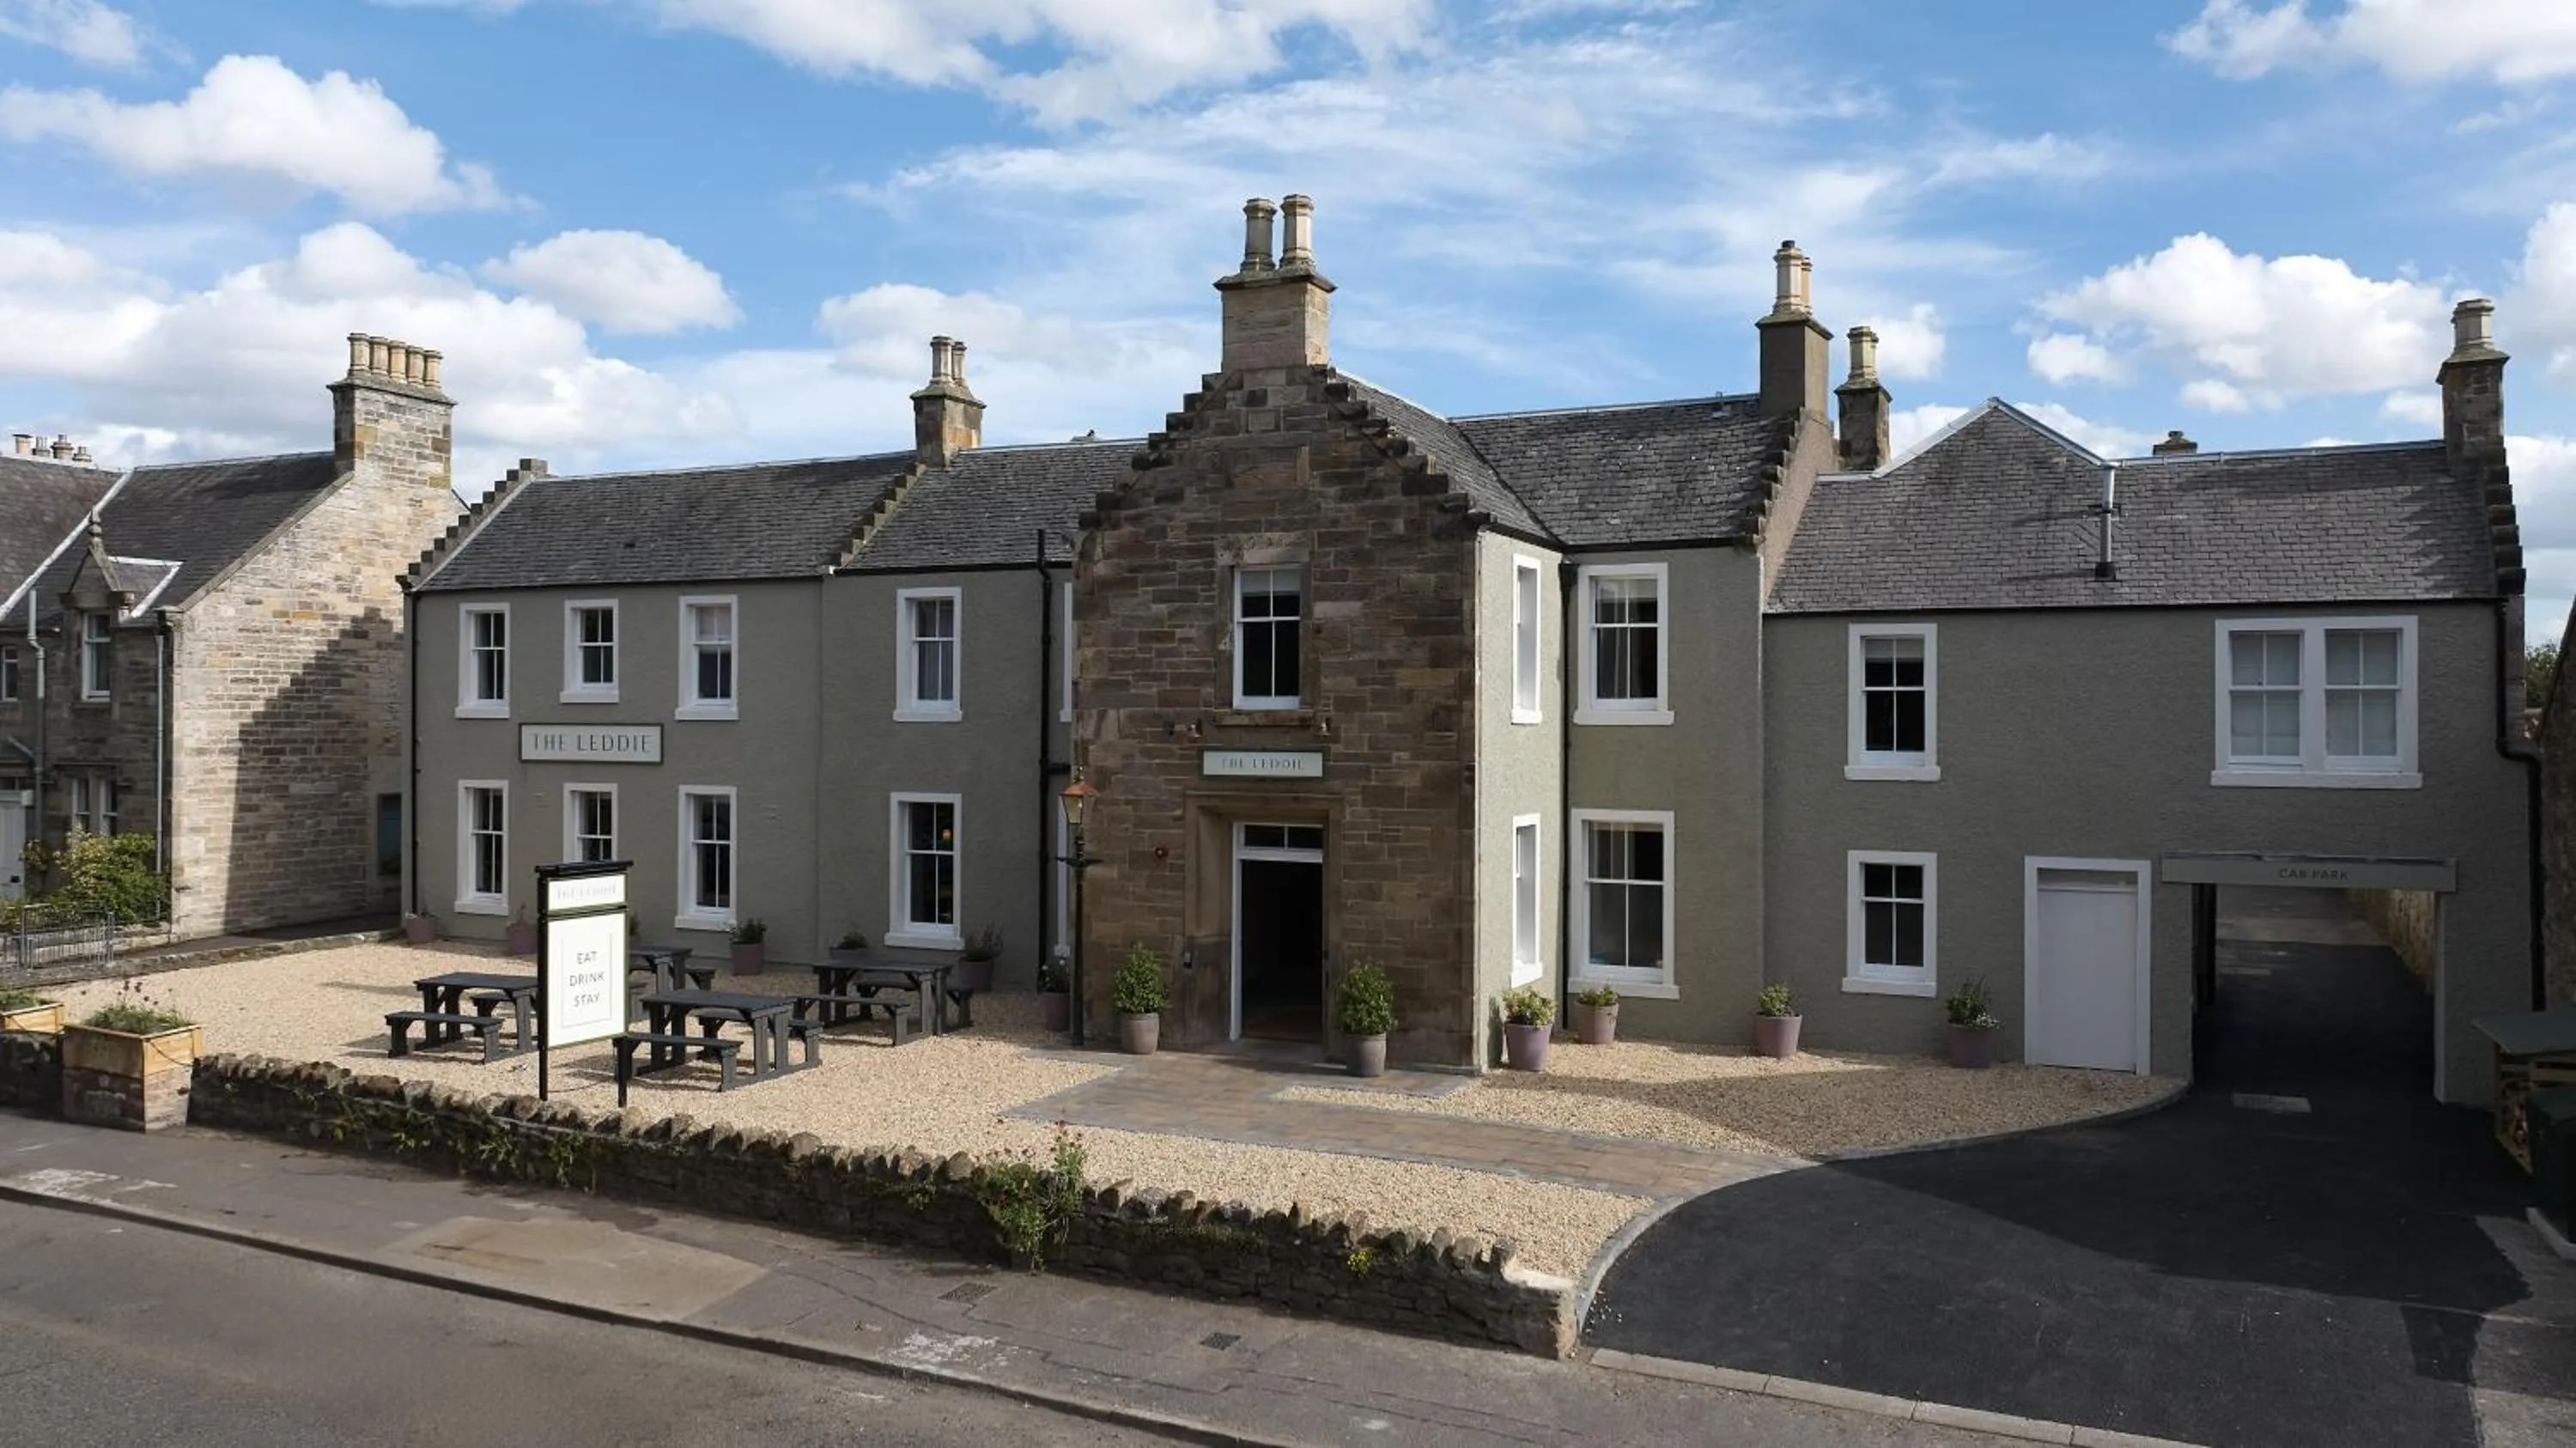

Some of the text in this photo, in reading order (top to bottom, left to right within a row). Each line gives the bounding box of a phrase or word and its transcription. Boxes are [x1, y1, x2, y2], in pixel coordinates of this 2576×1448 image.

[533, 733, 653, 752] THE LEDDIE
[2279, 867, 2349, 880] CAR PARK
[576, 951, 598, 964] EAT
[569, 971, 605, 987] DRINK
[574, 993, 600, 1007] STAY
